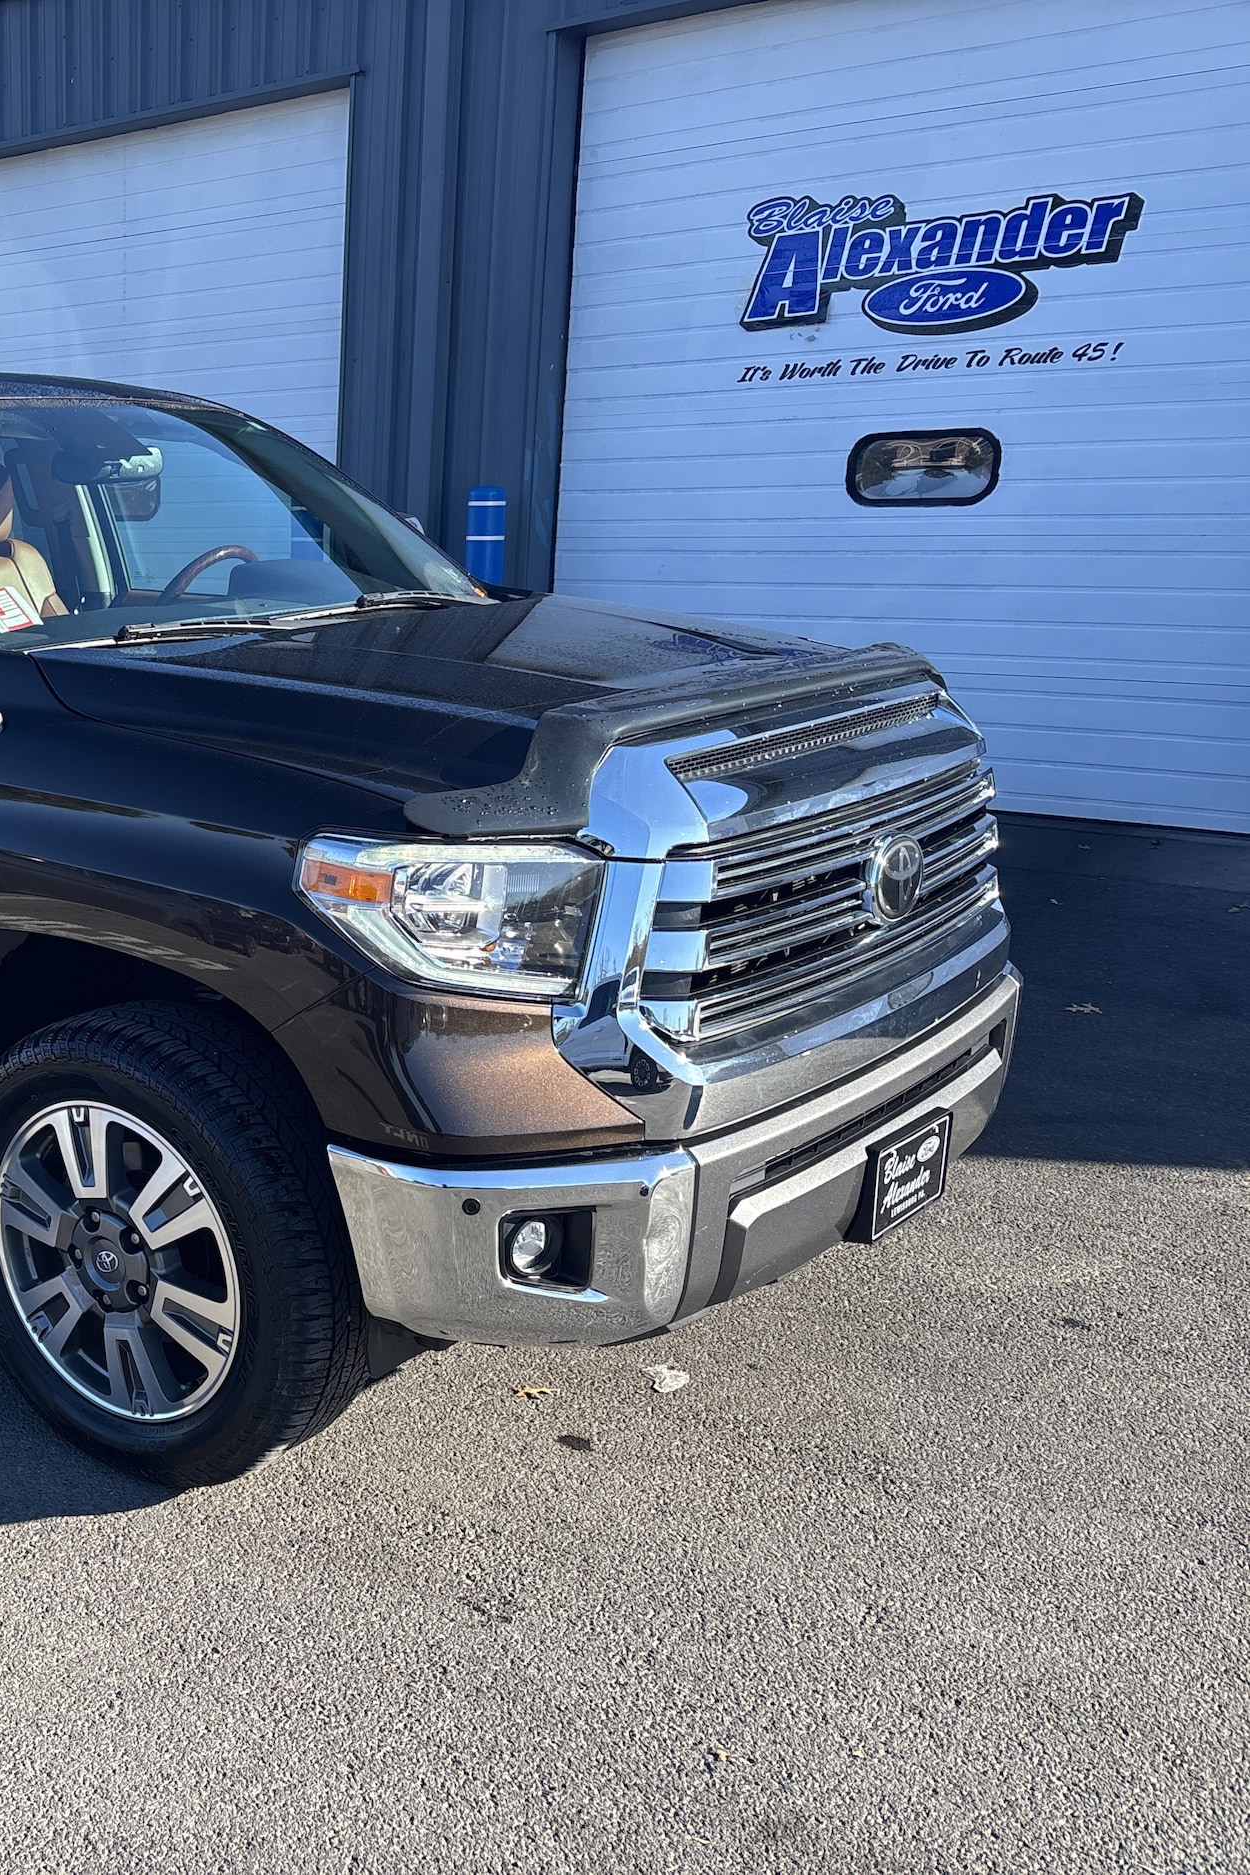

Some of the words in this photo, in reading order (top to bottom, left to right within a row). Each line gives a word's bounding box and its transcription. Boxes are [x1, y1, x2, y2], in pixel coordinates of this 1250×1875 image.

[752, 197, 895, 236] Blaise
[742, 195, 1131, 322] Alexander
[899, 278, 988, 314] Ford
[736, 365, 771, 383] It's
[778, 359, 843, 381] Worth
[850, 356, 886, 376] The
[896, 353, 957, 373] Drive
[965, 350, 992, 368] To
[998, 346, 1064, 366] Route
[883, 1154, 916, 1185] Blaise
[880, 1165, 931, 1214] Alexander
